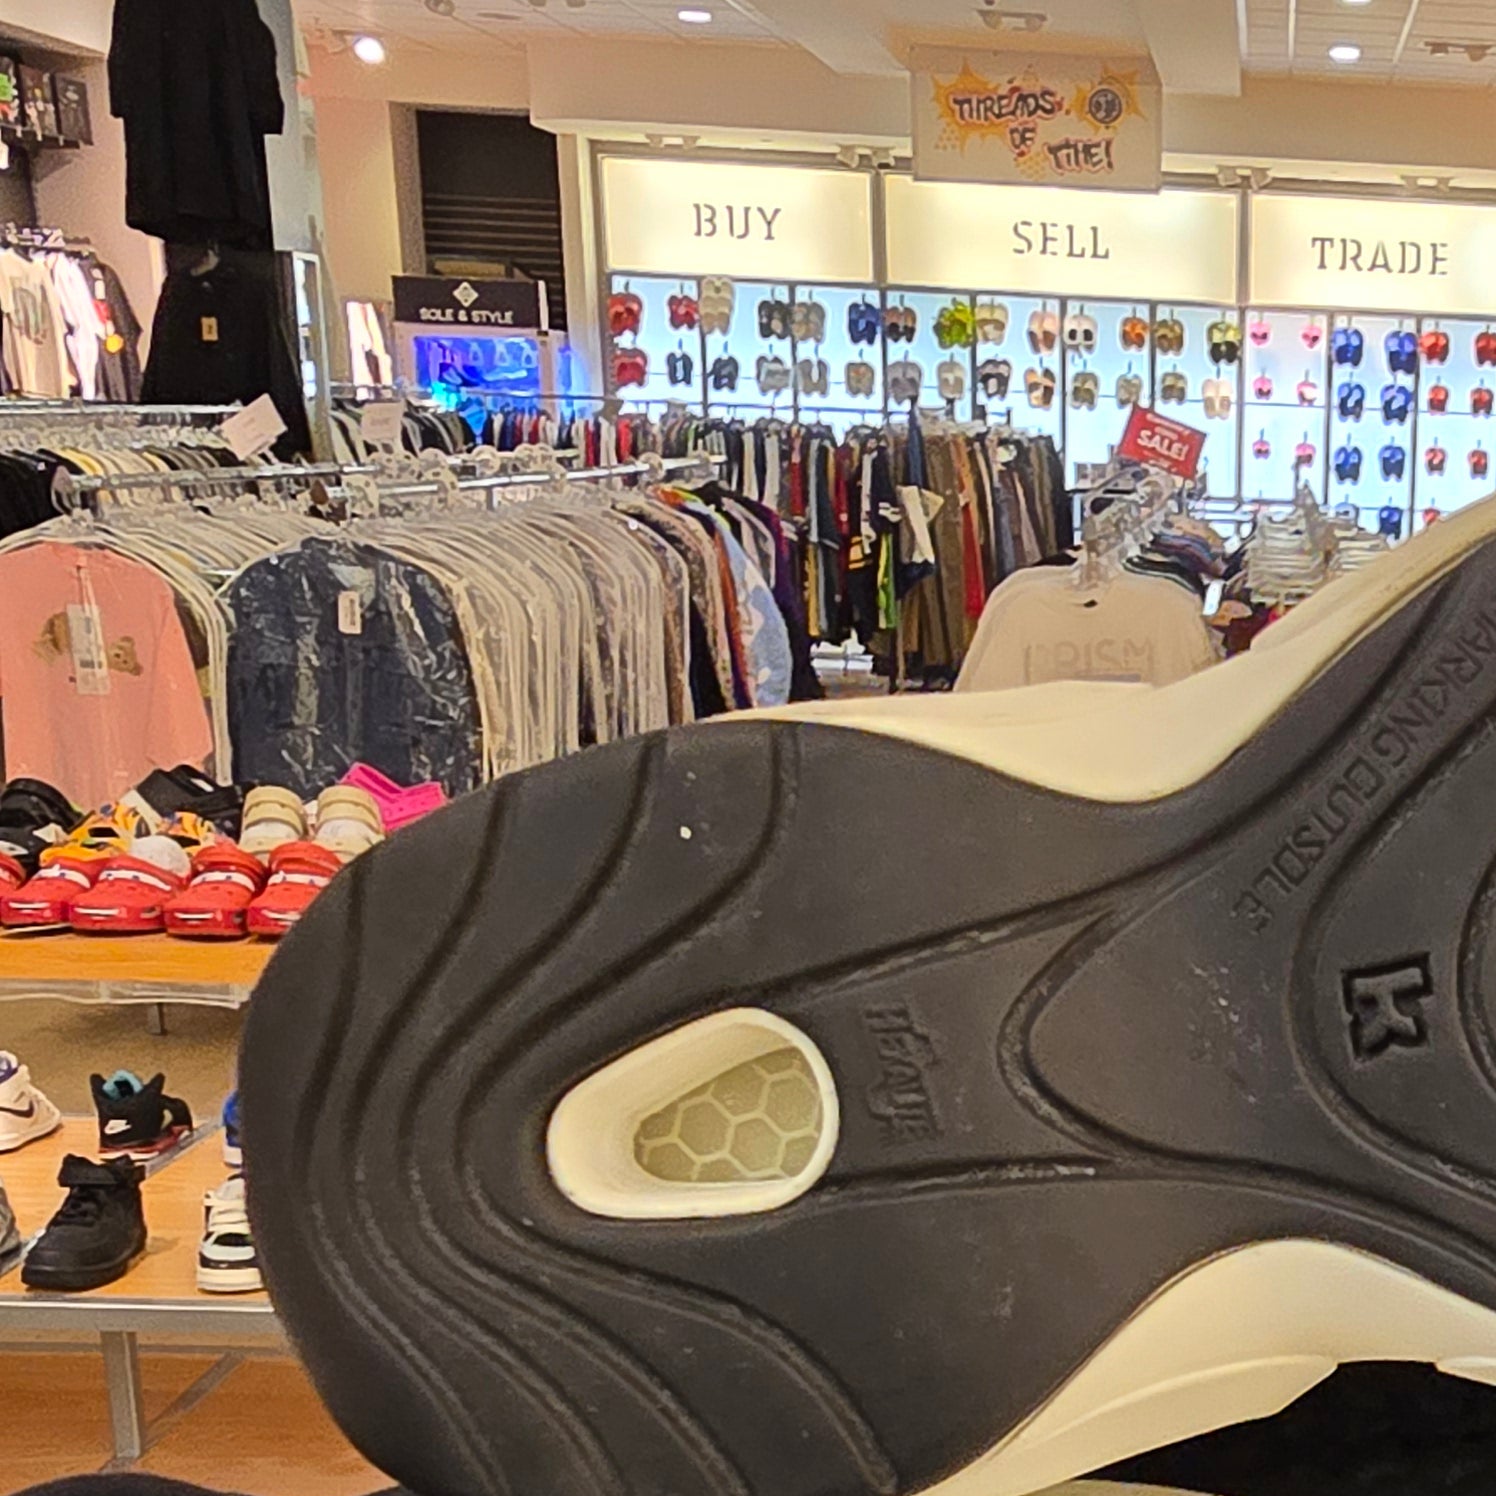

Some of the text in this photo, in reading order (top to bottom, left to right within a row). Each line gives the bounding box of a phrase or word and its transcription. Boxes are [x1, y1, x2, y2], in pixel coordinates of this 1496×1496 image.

[953, 90, 1056, 122] THREADS
[693, 203, 782, 240] BUY
[1012, 220, 1110, 260] SELL
[1311, 237, 1449, 276] TRADE
[419, 307, 514, 325] SOLE & STYLE
[1230, 756, 1386, 935] OUTSOLE
